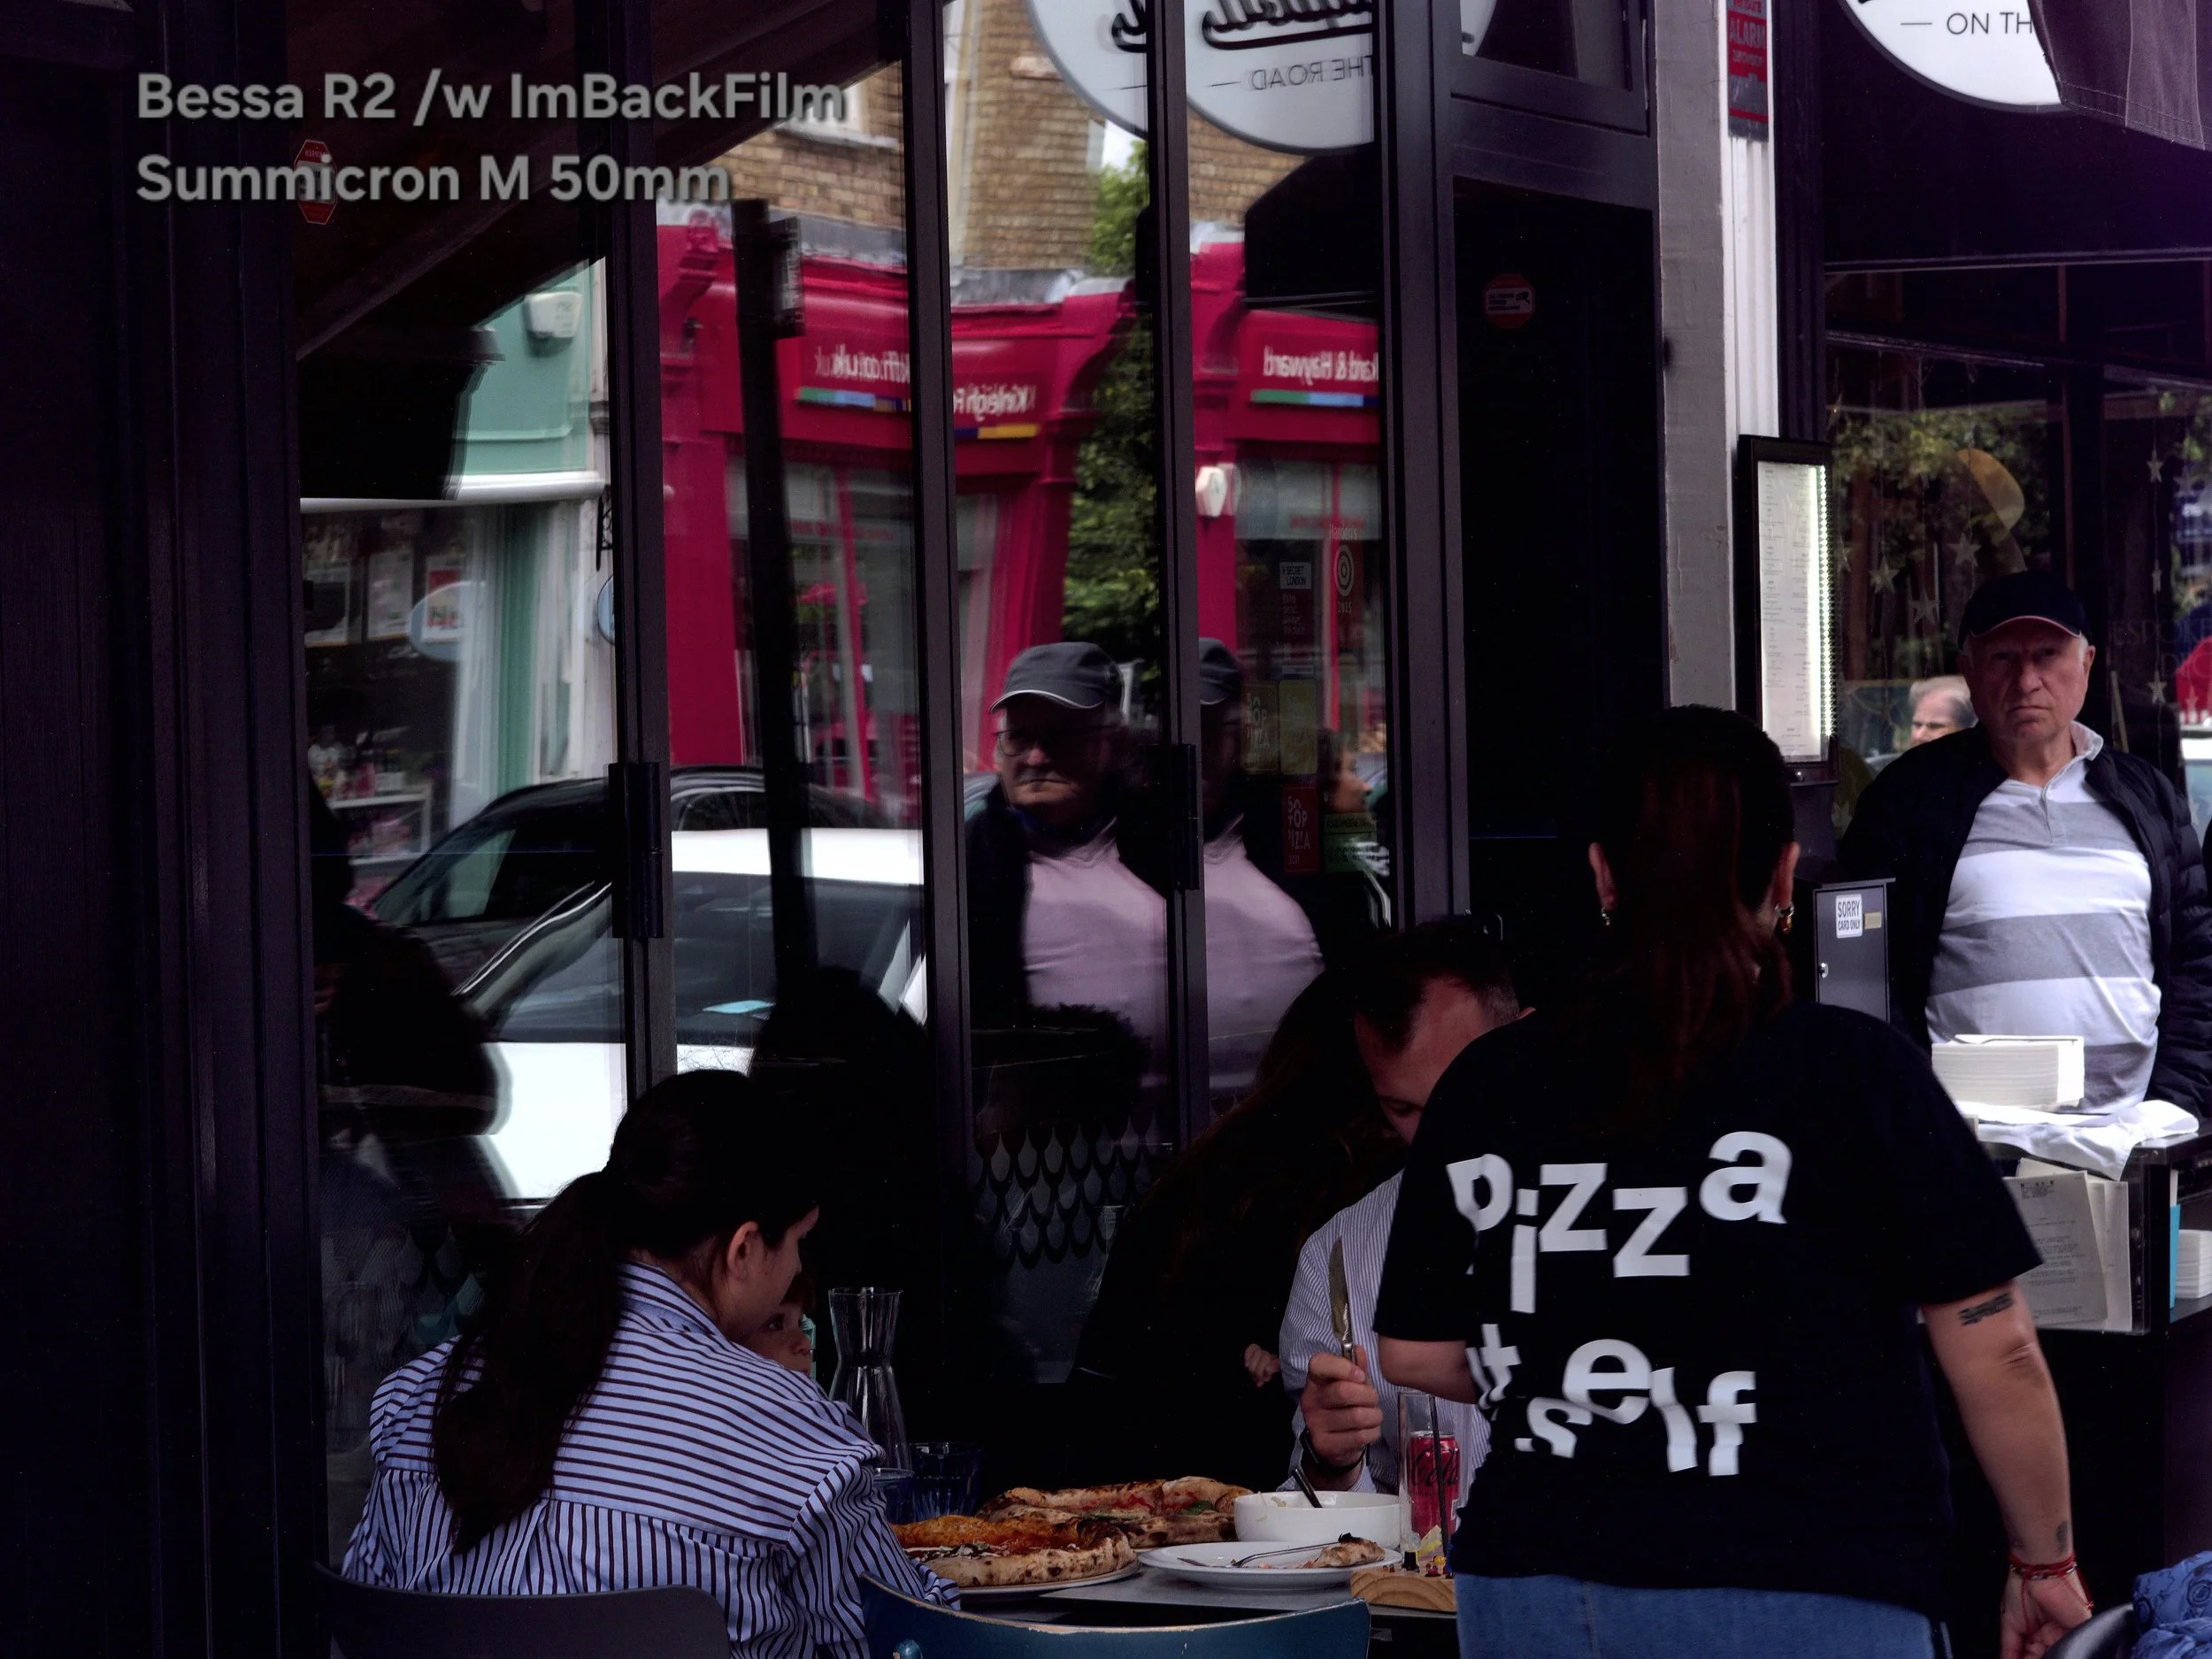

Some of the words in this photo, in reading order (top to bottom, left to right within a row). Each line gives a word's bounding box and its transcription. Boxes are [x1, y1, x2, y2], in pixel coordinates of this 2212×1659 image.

[1728, 17, 1766, 50] ALARM
[1947, 12, 1989, 35] ON
[2000, 12, 2033, 35] TH
[1838, 900, 1861, 918] SORRY
[1838, 920, 1849, 931] CARD
[1850, 919, 1861, 930] ONLY
[1446, 1131, 1793, 1315] pizza
